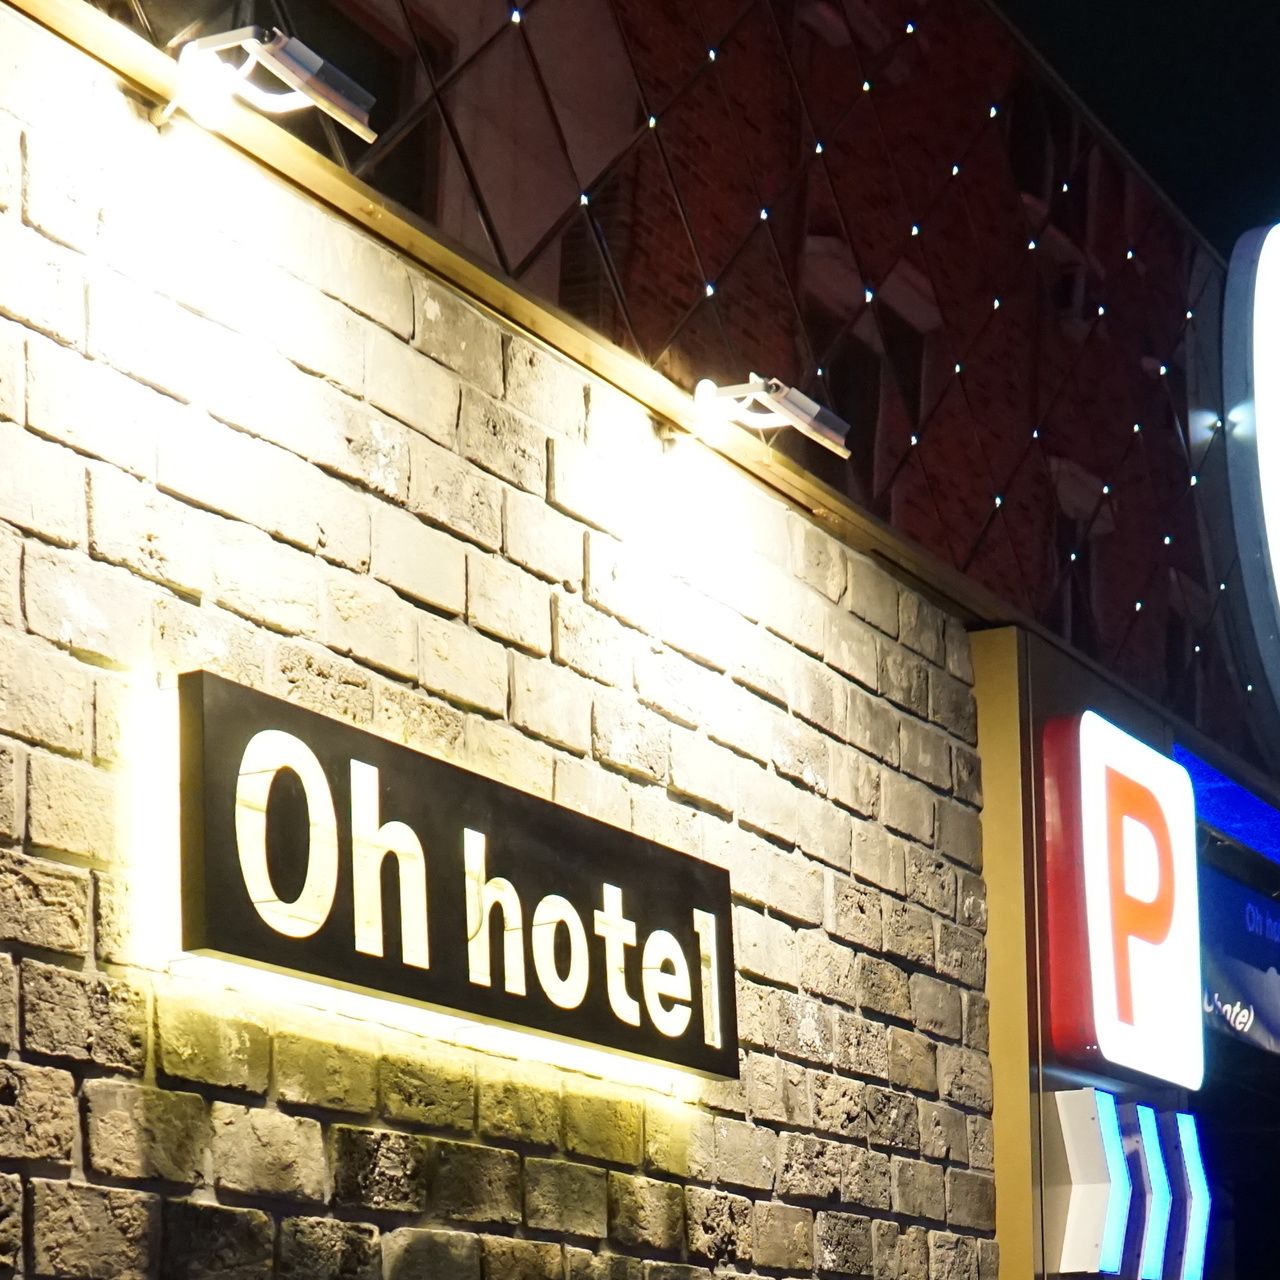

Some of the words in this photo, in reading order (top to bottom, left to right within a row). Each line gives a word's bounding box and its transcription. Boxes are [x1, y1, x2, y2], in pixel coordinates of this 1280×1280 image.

[234, 728, 431, 971] Oh
[463, 827, 724, 1050] hotel
[1105, 764, 1176, 1027] P
